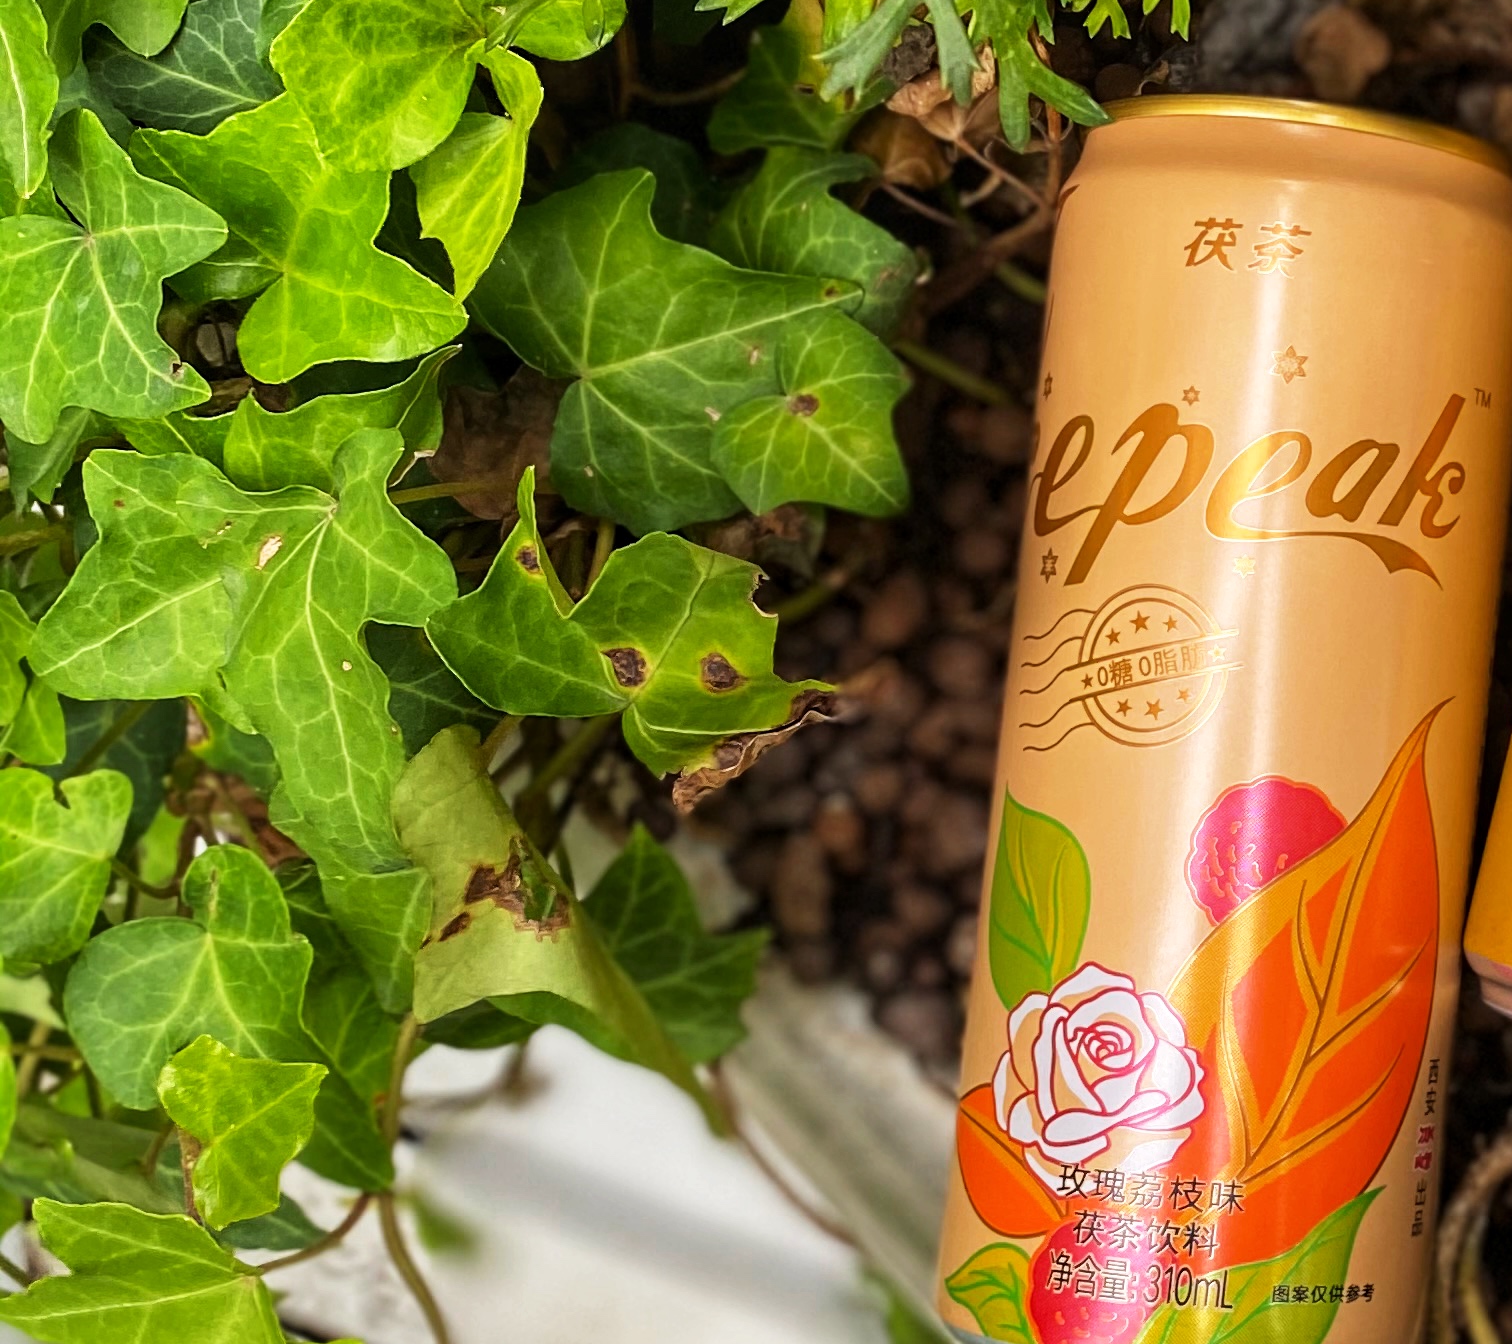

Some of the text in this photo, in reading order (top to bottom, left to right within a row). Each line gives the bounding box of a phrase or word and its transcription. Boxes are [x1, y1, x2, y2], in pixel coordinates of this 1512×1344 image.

[1183, 216, 1312, 279] 茯茶
[1030, 393, 1467, 591] epeak
[1097, 658, 1133, 687] 0糖
[1057, 1163, 1246, 1215] 玫瑰荔枝味
[1072, 1209, 1220, 1259] 茯茶饮料
[1270, 1283, 1376, 1305] 图案仅供参考
